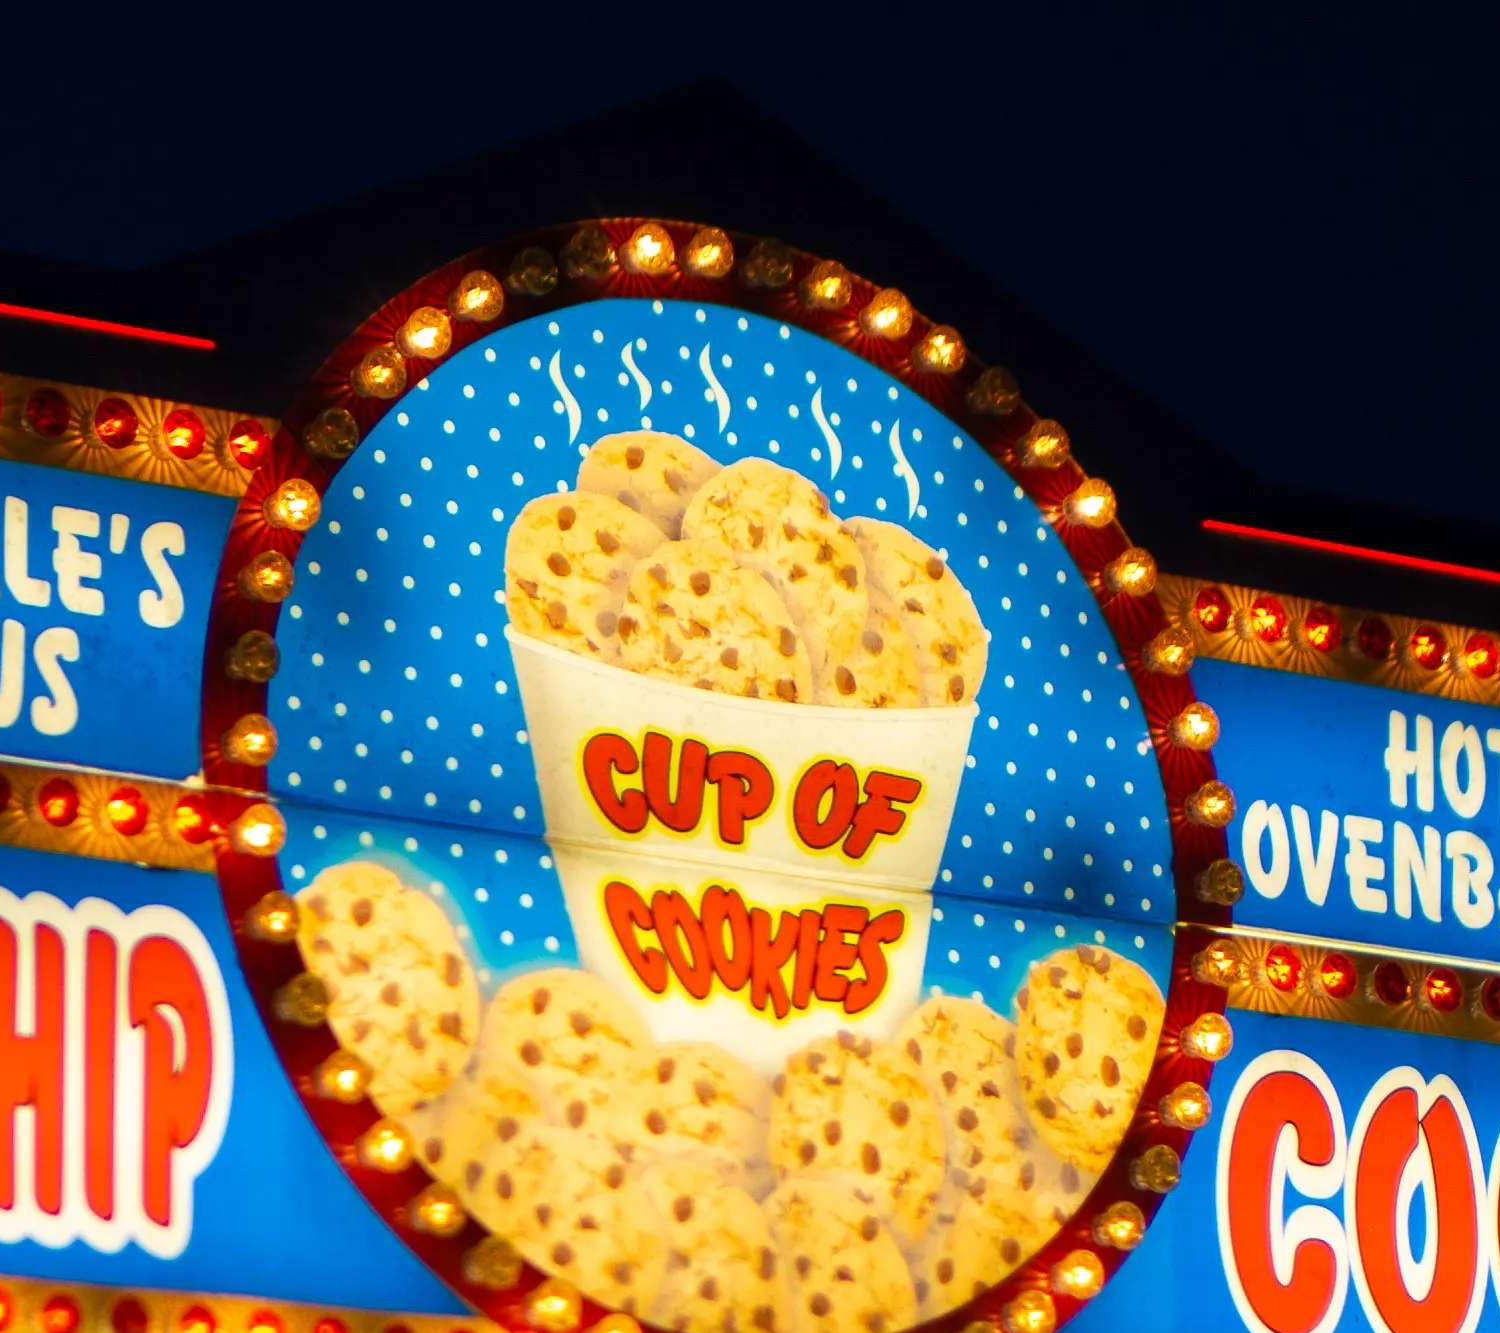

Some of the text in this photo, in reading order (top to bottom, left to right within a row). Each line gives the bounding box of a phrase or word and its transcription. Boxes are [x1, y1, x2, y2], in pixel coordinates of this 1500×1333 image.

[580, 726, 923, 861] CUP OF
[602, 875, 909, 1020] COOKIES
